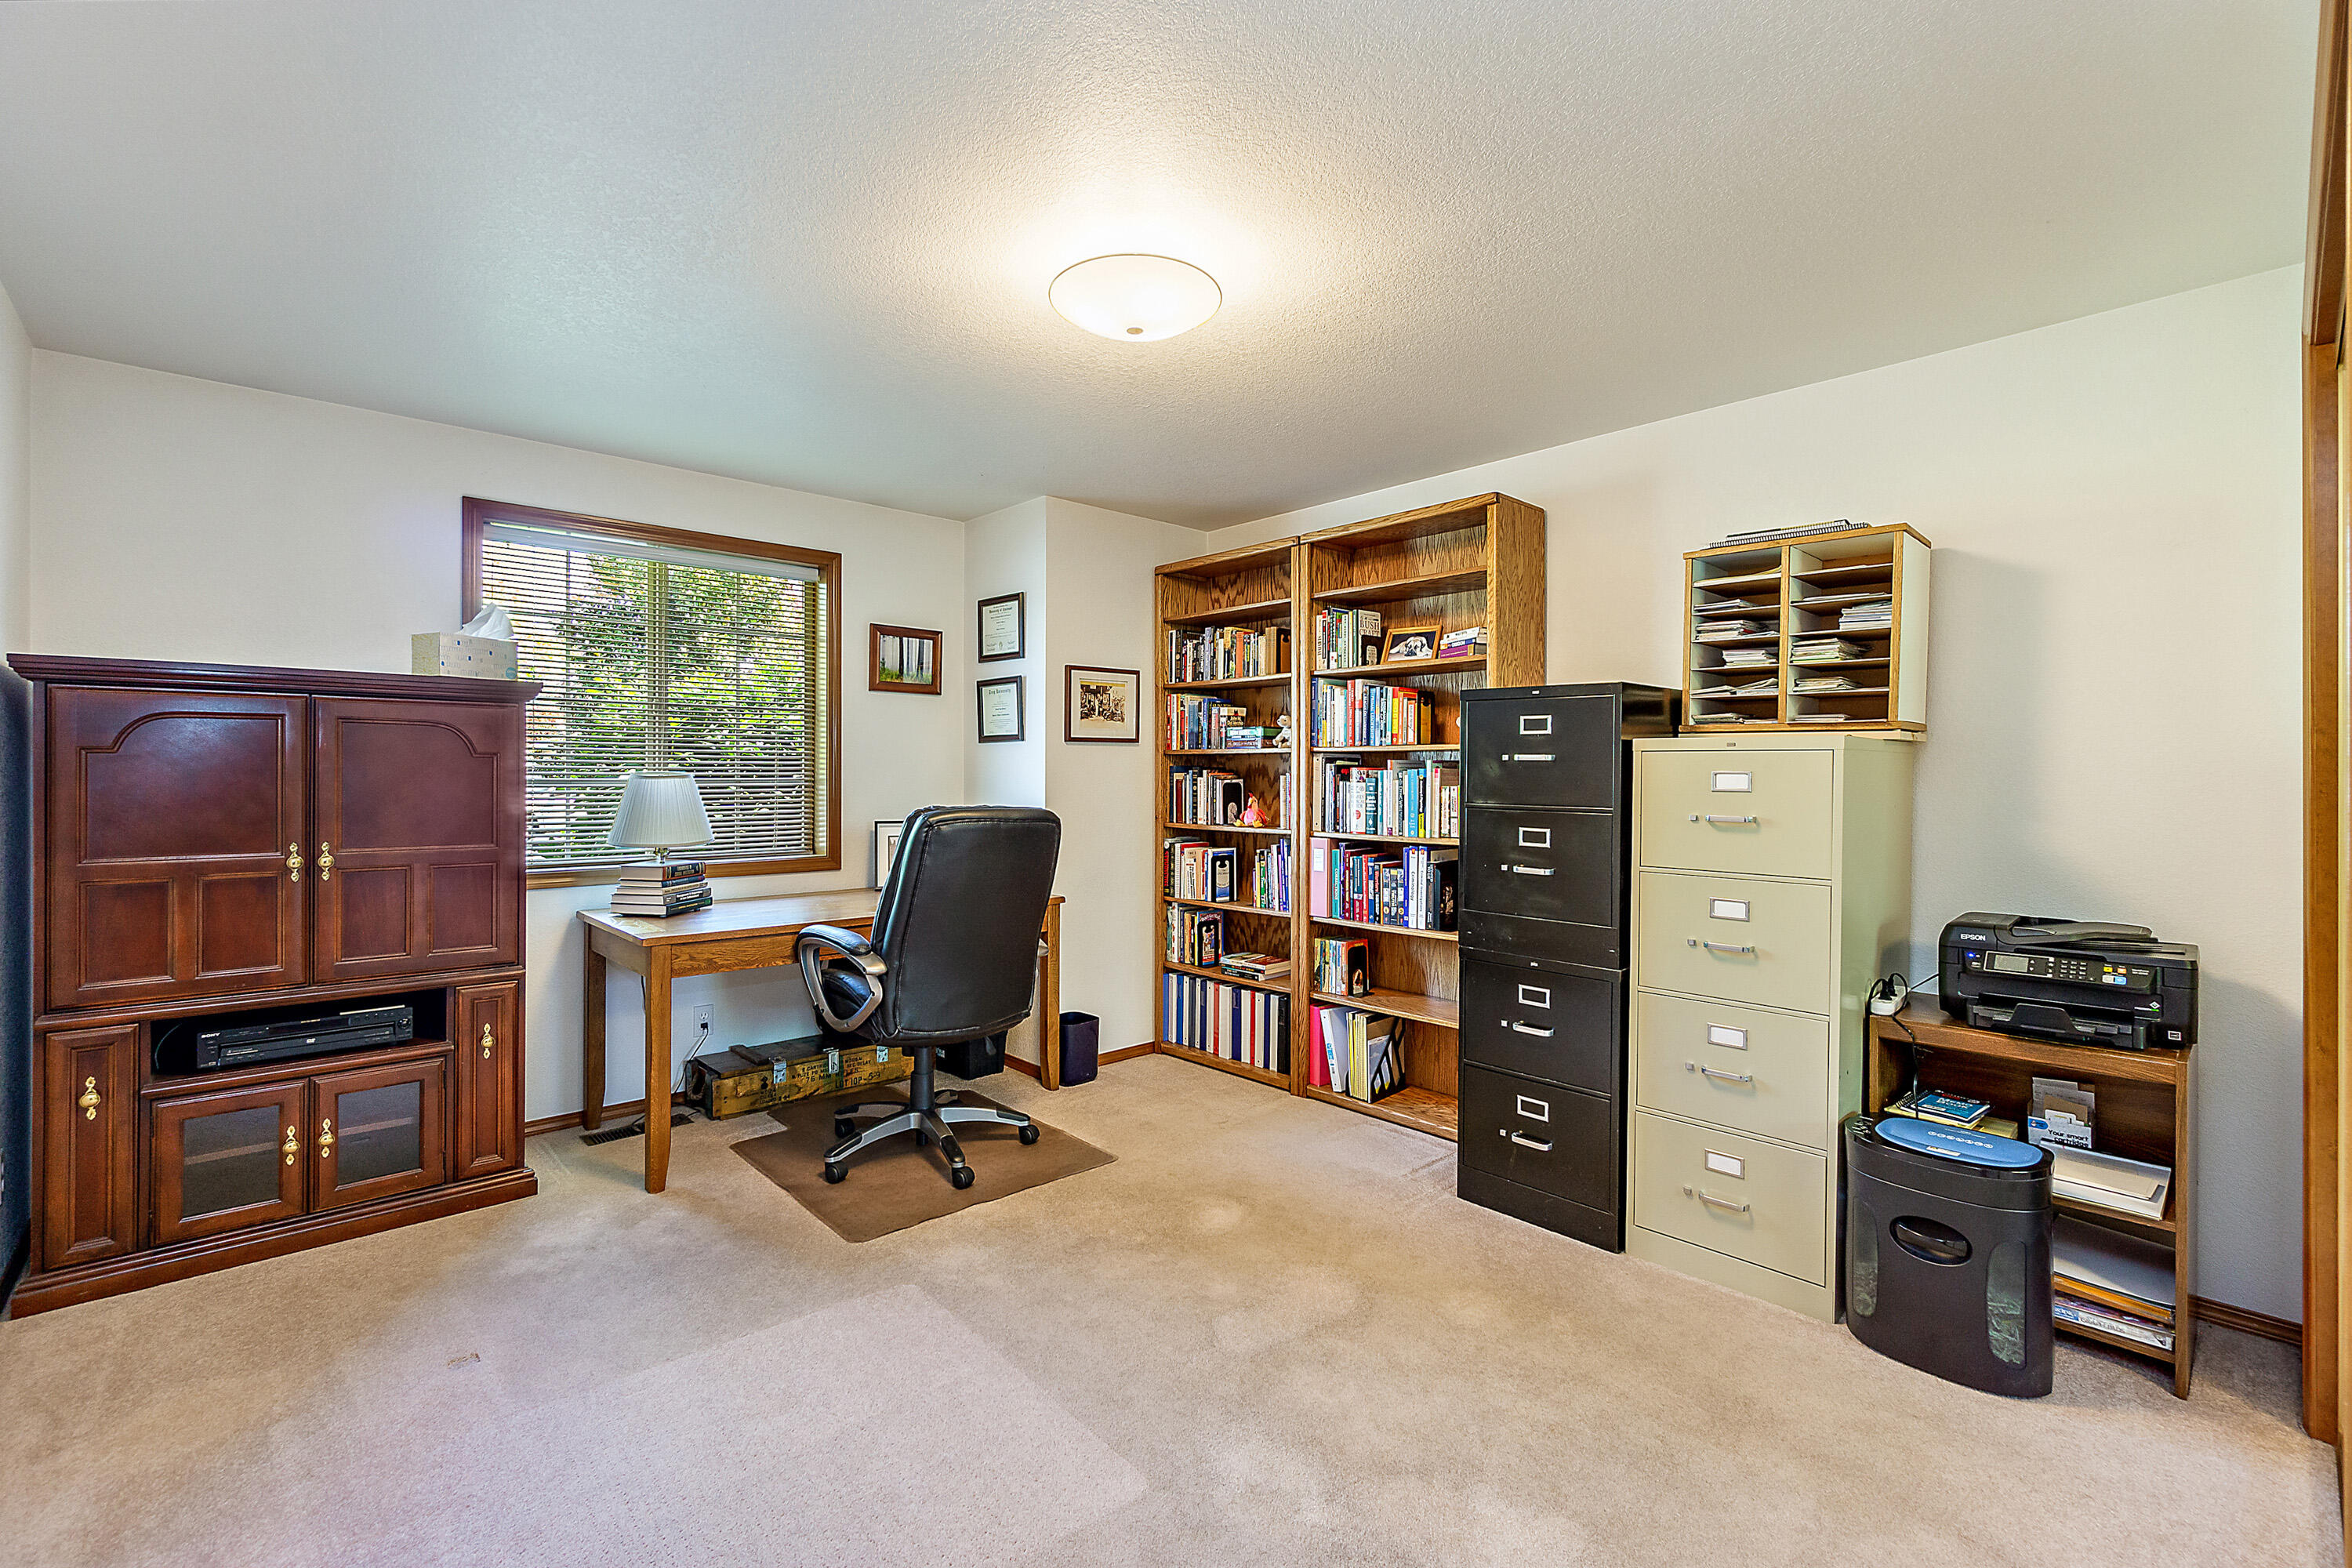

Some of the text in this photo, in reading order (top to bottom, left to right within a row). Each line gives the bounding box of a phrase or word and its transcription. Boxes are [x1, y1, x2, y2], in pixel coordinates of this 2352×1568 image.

[1359, 619, 1380, 630] BUSH
[1960, 933, 1986, 942] EPSON
[836, 1080, 848, 1088] LOT
[2048, 1128, 2089, 1143] Your smart
[2054, 1138, 2089, 1149] cartridge
